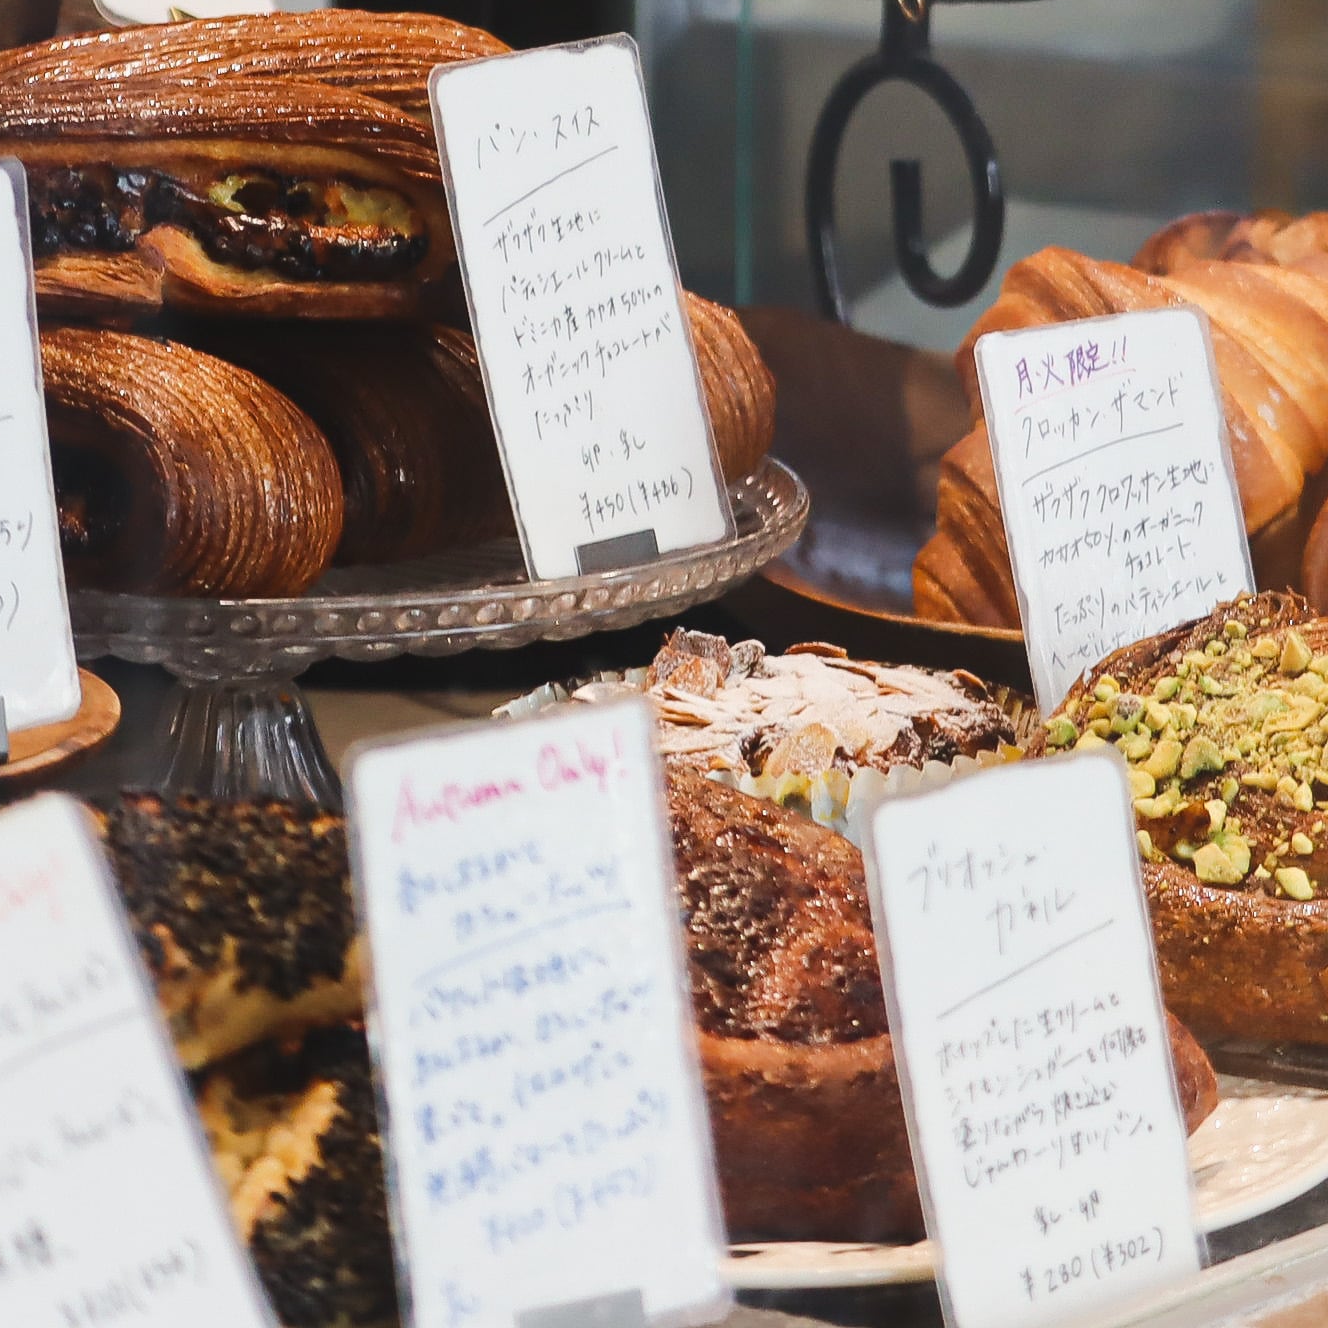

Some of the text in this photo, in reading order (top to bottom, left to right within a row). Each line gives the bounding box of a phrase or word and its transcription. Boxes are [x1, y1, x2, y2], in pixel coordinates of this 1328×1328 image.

[492, 207, 602, 264] ザクザク生地に
